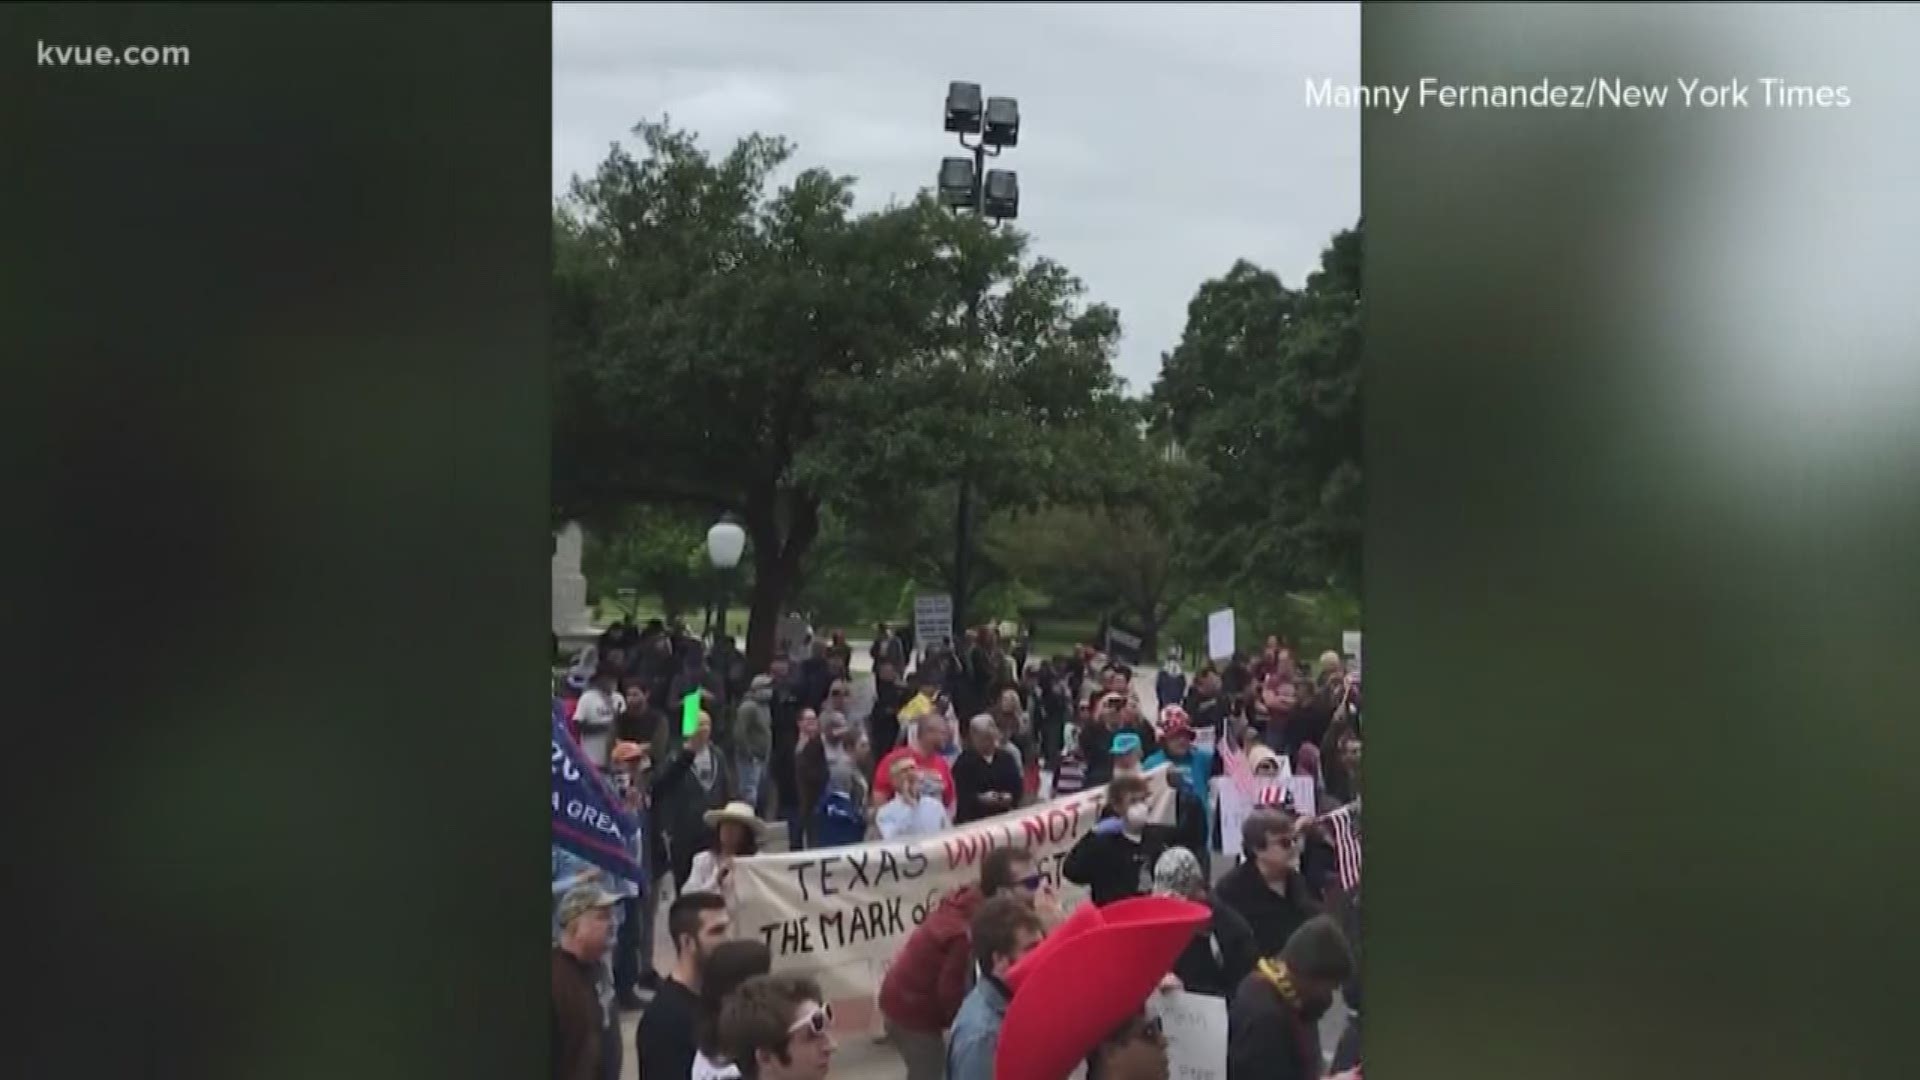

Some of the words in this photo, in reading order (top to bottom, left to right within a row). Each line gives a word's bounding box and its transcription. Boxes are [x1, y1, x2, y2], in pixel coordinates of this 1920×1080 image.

[788, 845, 928, 901] TEXAS
[1021, 802, 1080, 851] NOT
[760, 917, 814, 956] THE
[819, 896, 904, 949] MARK
